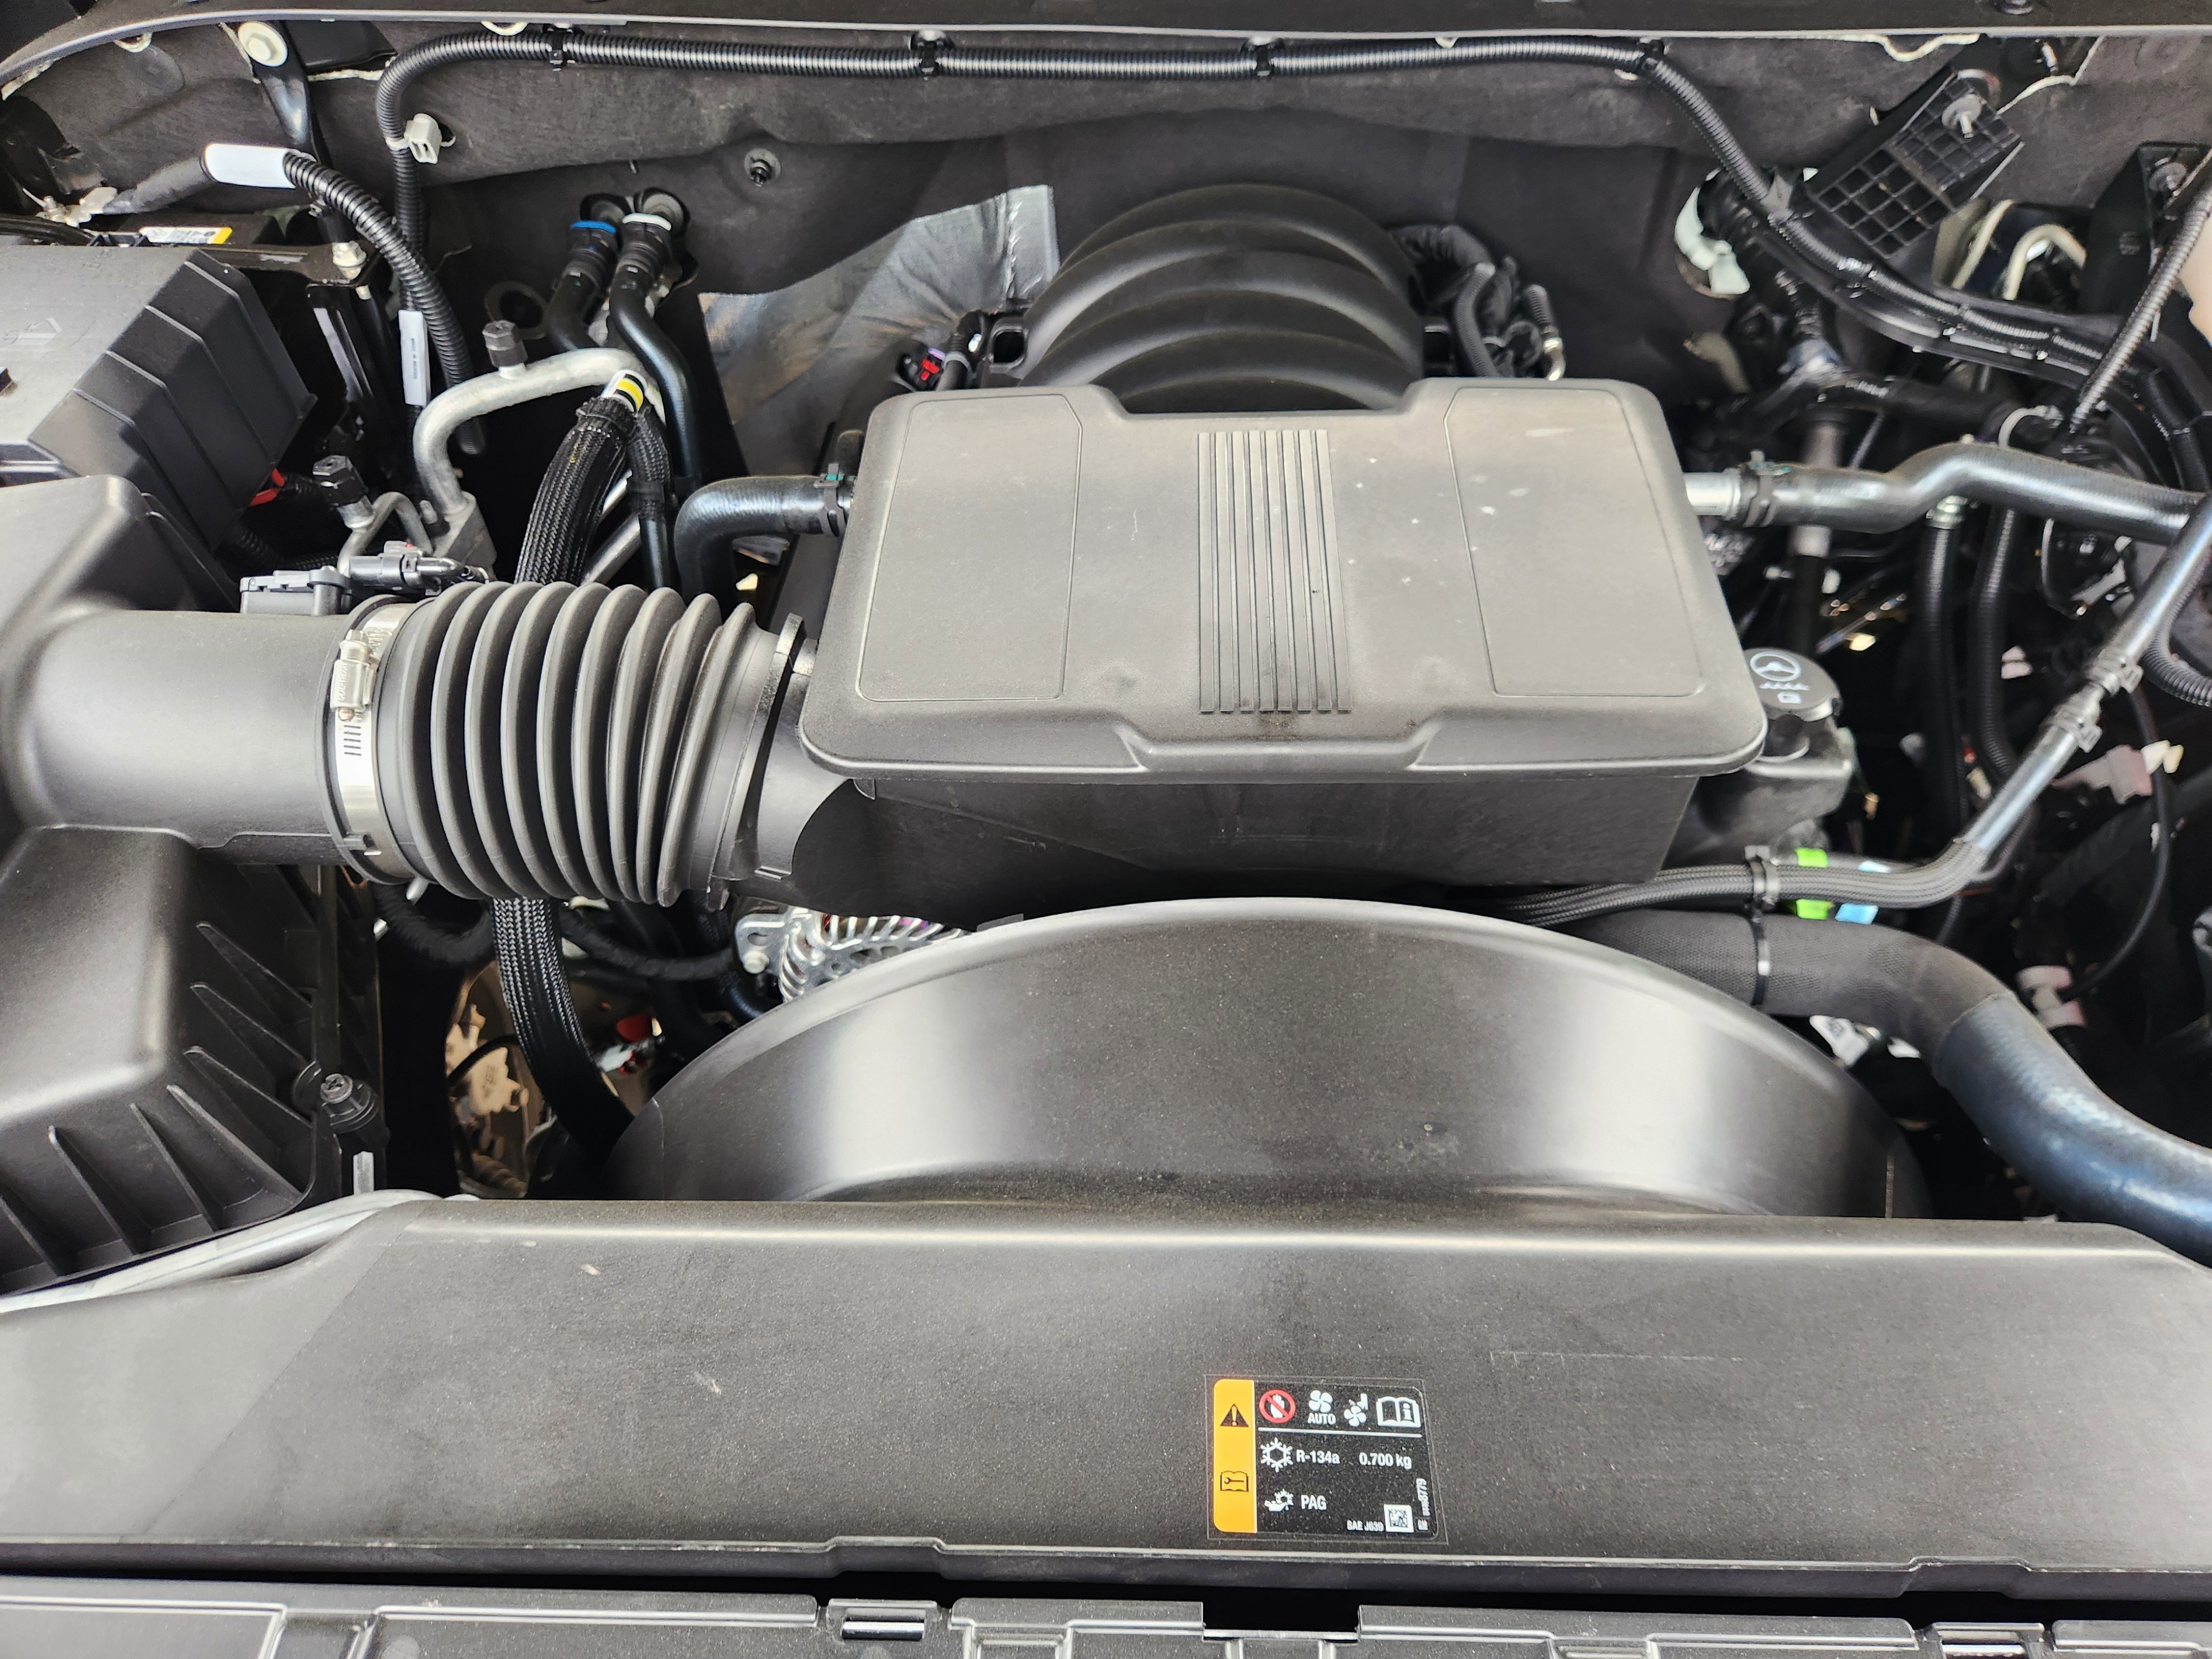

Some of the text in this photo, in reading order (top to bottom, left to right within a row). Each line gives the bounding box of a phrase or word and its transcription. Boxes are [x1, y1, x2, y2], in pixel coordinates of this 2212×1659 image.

[1307, 1413, 1337, 1425] AUTO
[1296, 1449, 1340, 1464] R-134a
[1359, 1452, 1412, 1470] 0.700 kg
[1300, 1494, 1327, 1510] PAG
[1347, 1520, 1364, 1531] SAE
